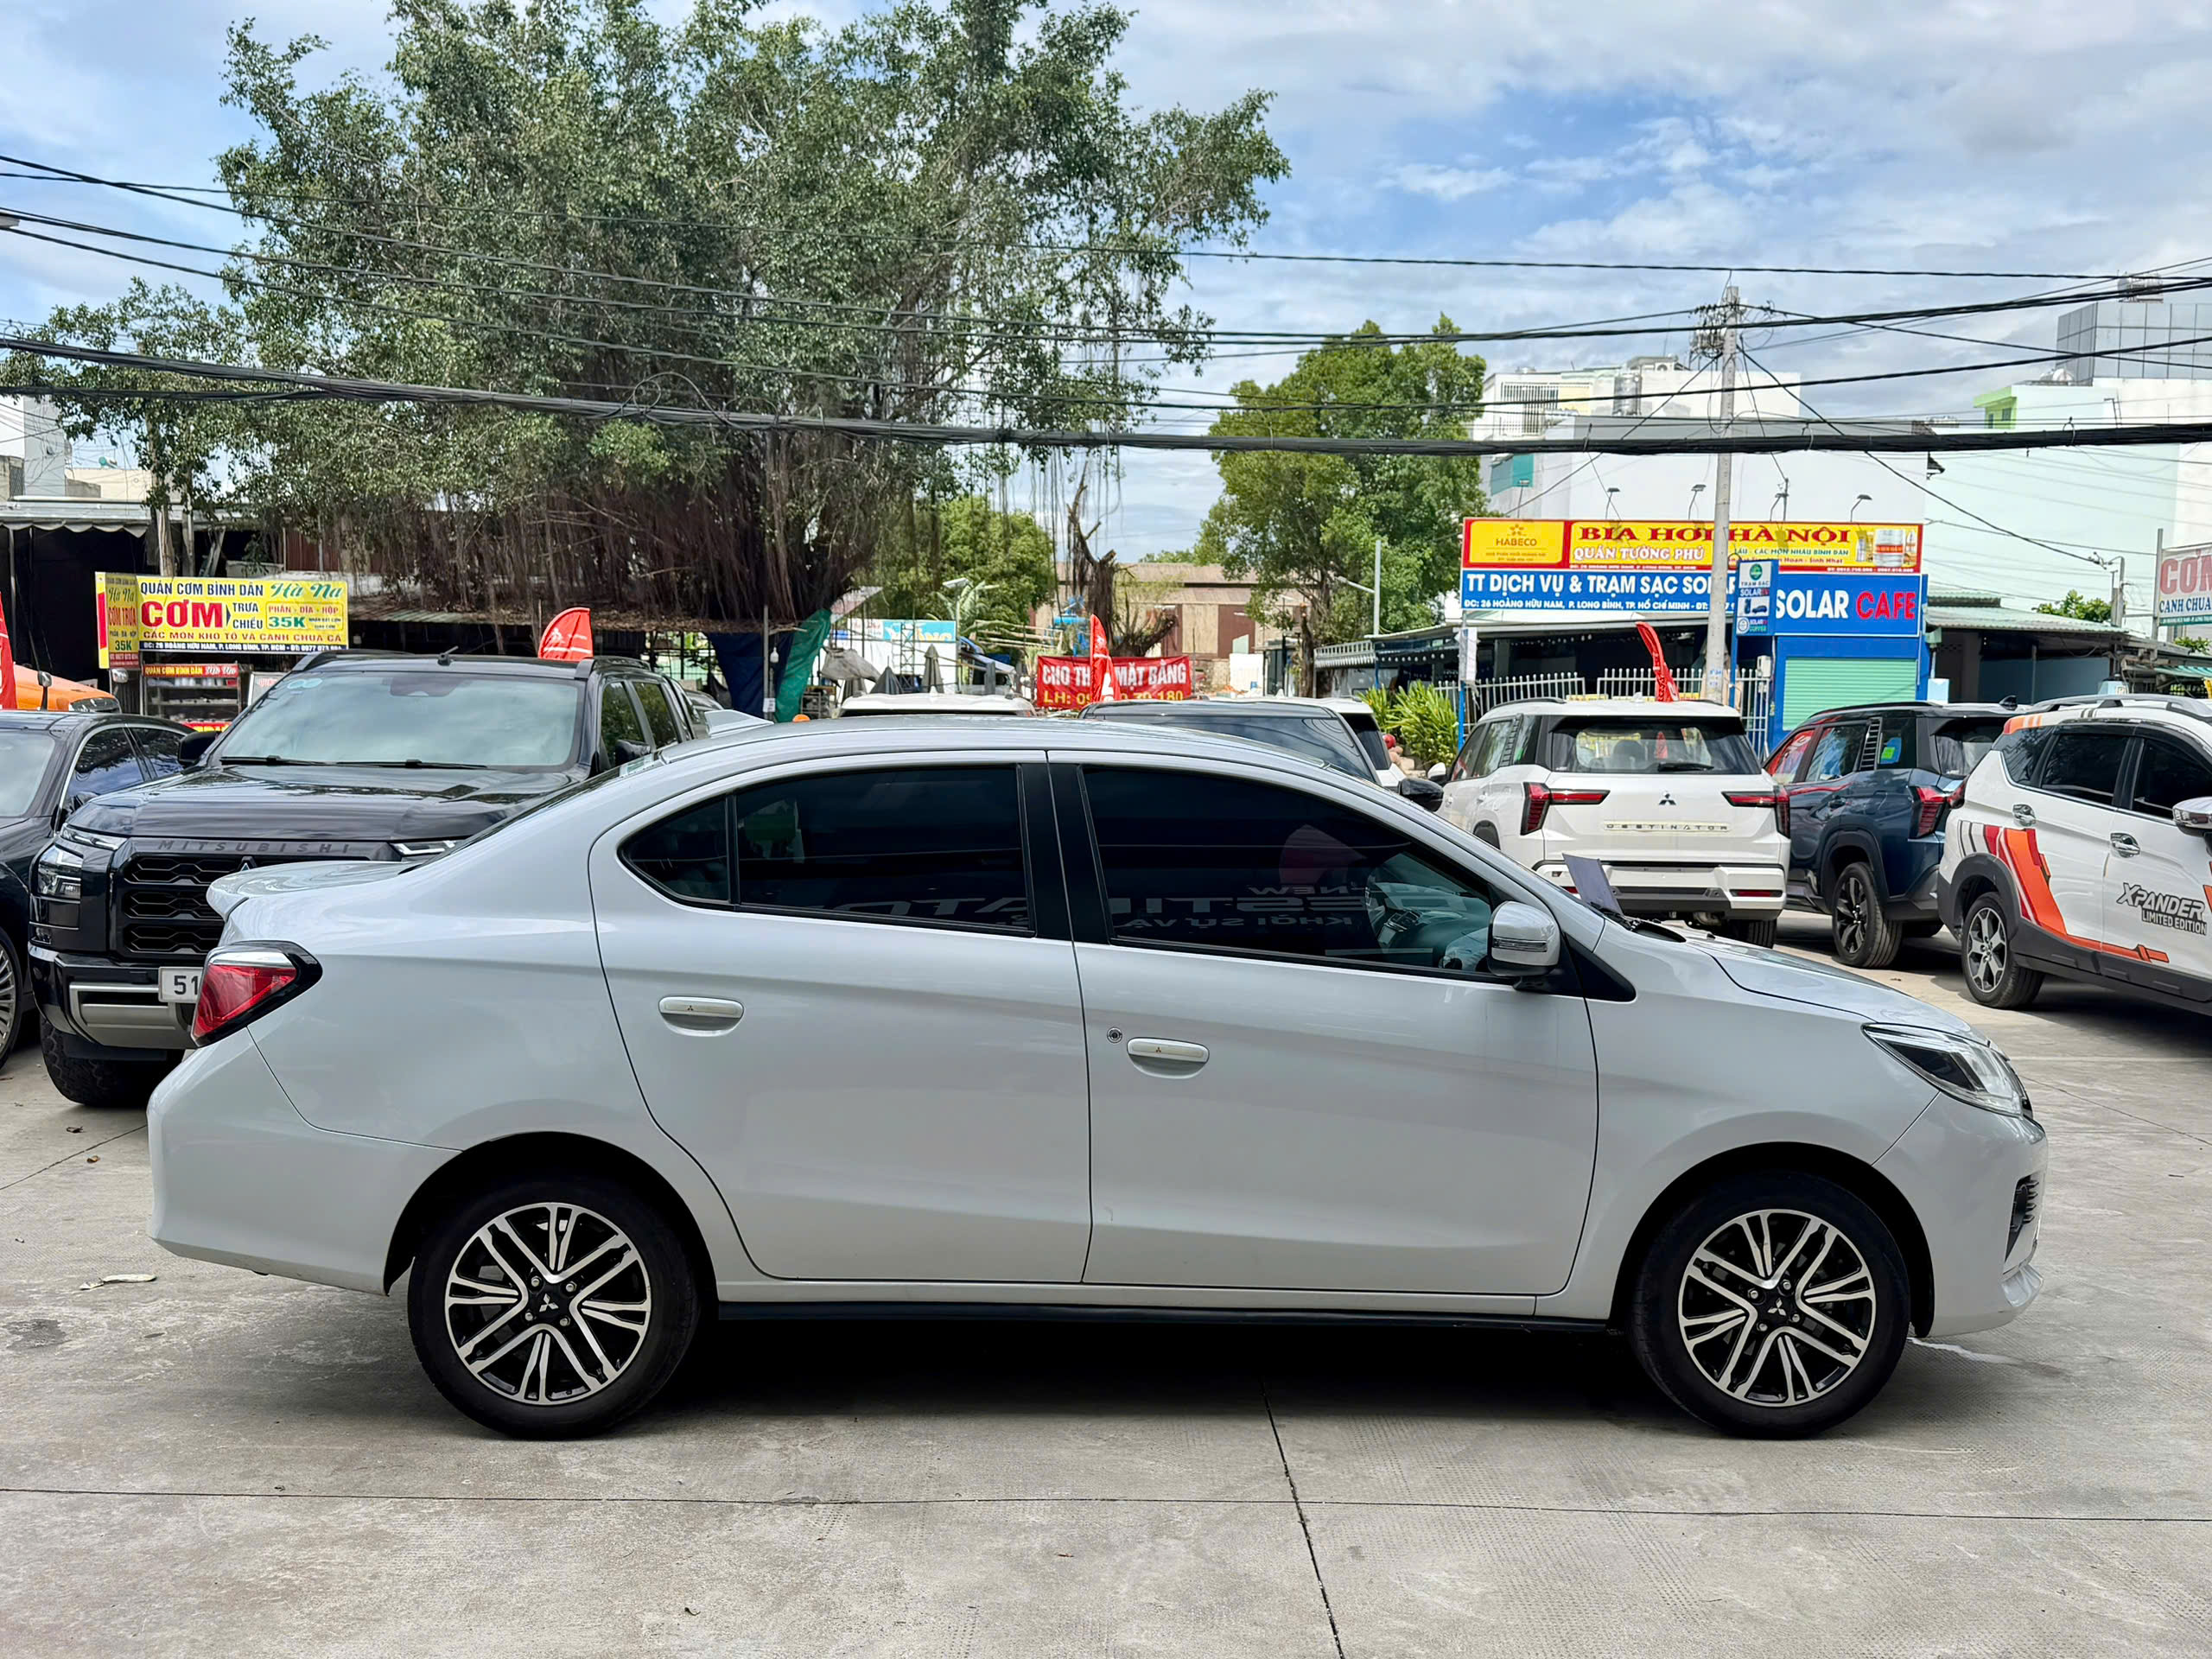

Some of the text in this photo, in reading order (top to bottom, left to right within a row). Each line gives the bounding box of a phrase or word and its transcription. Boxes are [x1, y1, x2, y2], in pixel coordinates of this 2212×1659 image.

[1580, 525, 1851, 545] BIA HƠI HÀ NỘI
[1573, 545, 1617, 561] QUÁN
[1674, 546, 1705, 561] PHÚ
[141, 580, 173, 594] QUÁN
[177, 582, 203, 594] CƠM
[207, 581, 235, 595] BÌNH
[239, 582, 264, 596] DÂN
[310, 583, 343, 599] Na
[1466, 573, 1485, 592] TT
[1489, 574, 1535, 597] DỊCH
[1539, 574, 1564, 598] VỤ
[1569, 575, 1583, 593] &
[1587, 575, 1636, 598] TRẠM
[1640, 575, 1679, 598] SẠC
[1480, 599, 1491, 608] 26
[1492, 597, 1523, 608] HOÀNG
[1525, 598, 1542, 608] HỮU
[1577, 601, 1599, 609] LONG
[1602, 598, 1624, 610] BÌNH,
[1668, 601, 1690, 610] MINH
[1776, 589, 1916, 620] SOLAR CAFE
[2159, 597, 2212, 613] CANH CHUA
[142, 599, 258, 628] CƠM TRƯA
[269, 615, 306, 628] 35K
[115, 640, 132, 651] 35K
[1043, 659, 1186, 690] CHO TH MẶT BẰNG
[1044, 690, 1071, 704] LH:
[158, 839, 350, 854] MITSUBISHI
[2116, 882, 2205, 922] XPANDER
[2143, 909, 2207, 936] LIMITED EDITION
